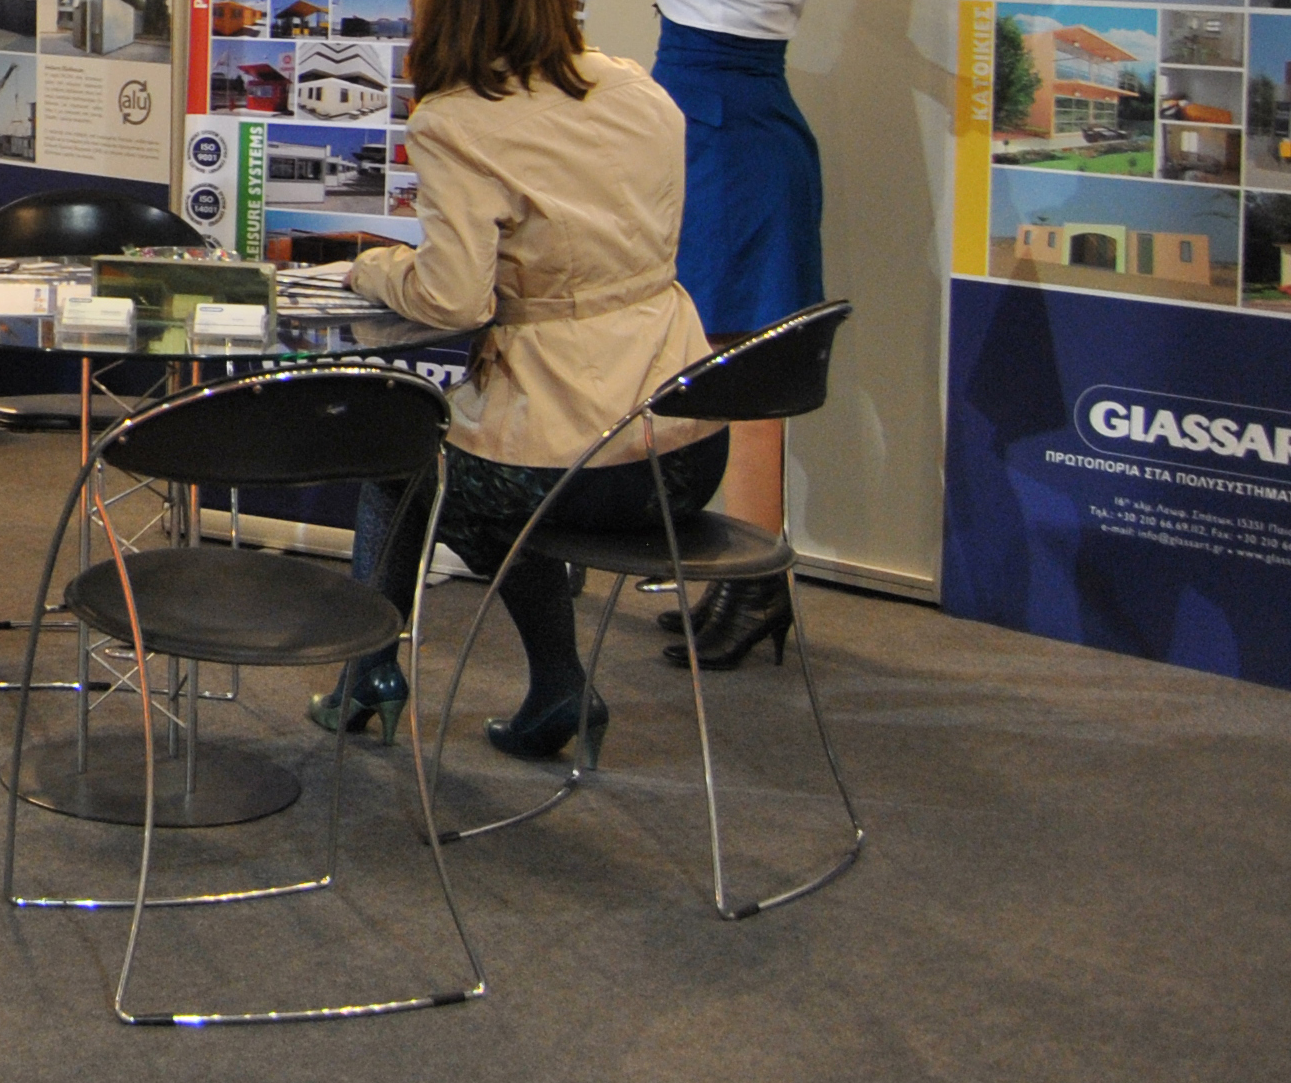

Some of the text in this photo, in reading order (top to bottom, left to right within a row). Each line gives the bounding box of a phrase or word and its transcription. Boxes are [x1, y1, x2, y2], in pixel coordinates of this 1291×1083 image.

[200, 143, 216, 151] ISO
[248, 125, 265, 196] SYSTEMS
[199, 195, 214, 203] ISO
[1045, 450, 1140, 477] ΠΡΩΤΟΠΟΡΙΑ
[1144, 467, 1171, 483] ΣΤΑ
